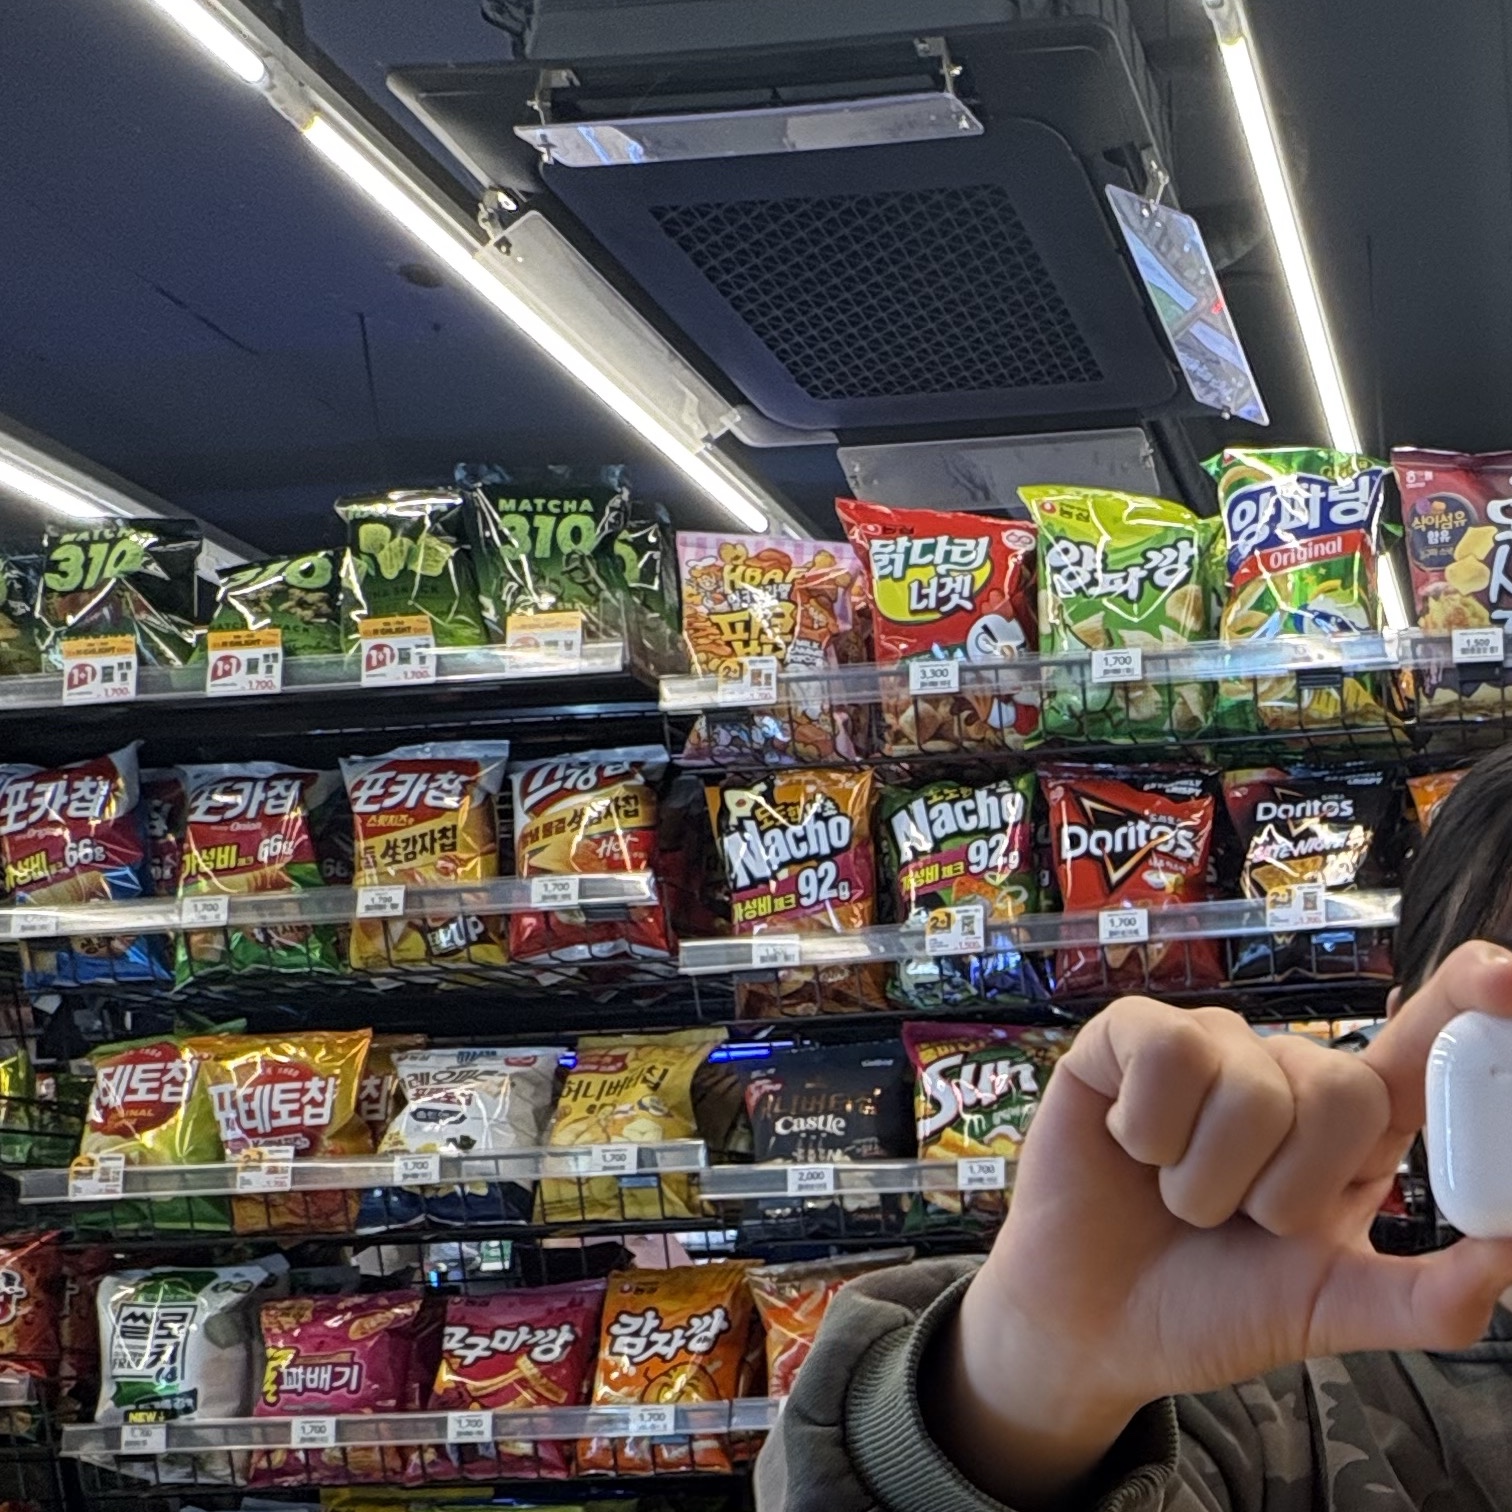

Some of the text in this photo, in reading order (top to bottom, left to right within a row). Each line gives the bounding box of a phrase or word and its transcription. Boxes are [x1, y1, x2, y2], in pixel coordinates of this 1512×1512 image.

[498, 498, 595, 514] MATCHA
[1228, 472, 1377, 552] 양파링
[500, 513, 598, 562] 310
[869, 534, 991, 582] 닭다리
[1268, 536, 1343, 572] Original
[43, 539, 148, 593] 310
[1046, 536, 1198, 602] 양파깡
[909, 573, 975, 613] 너겟
[919, 667, 950, 680] 3,300
[1103, 655, 1133, 667] 1,700
[0, 774, 113, 837] 포카칩
[1256, 799, 1354, 823] Doritos
[891, 787, 1025, 866] Nacho
[1061, 820, 1198, 861] Doritos
[722, 813, 853, 889] Nacho
[966, 833, 1020, 875] 92g
[797, 860, 851, 907] 92g
[1108, 916, 1137, 929] 1,700
[560, 1064, 670, 1104] 허니버터칩
[916, 1052, 1040, 1141] Sun
[775, 1115, 848, 1137] Castle
[798, 1169, 826, 1182] 2,000
[441, 1322, 576, 1367] 고구마깡
[607, 1303, 731, 1365] 감자깡
[128, 1412, 157, 1424] NEW
[455, 1416, 484, 1429] 1,700
